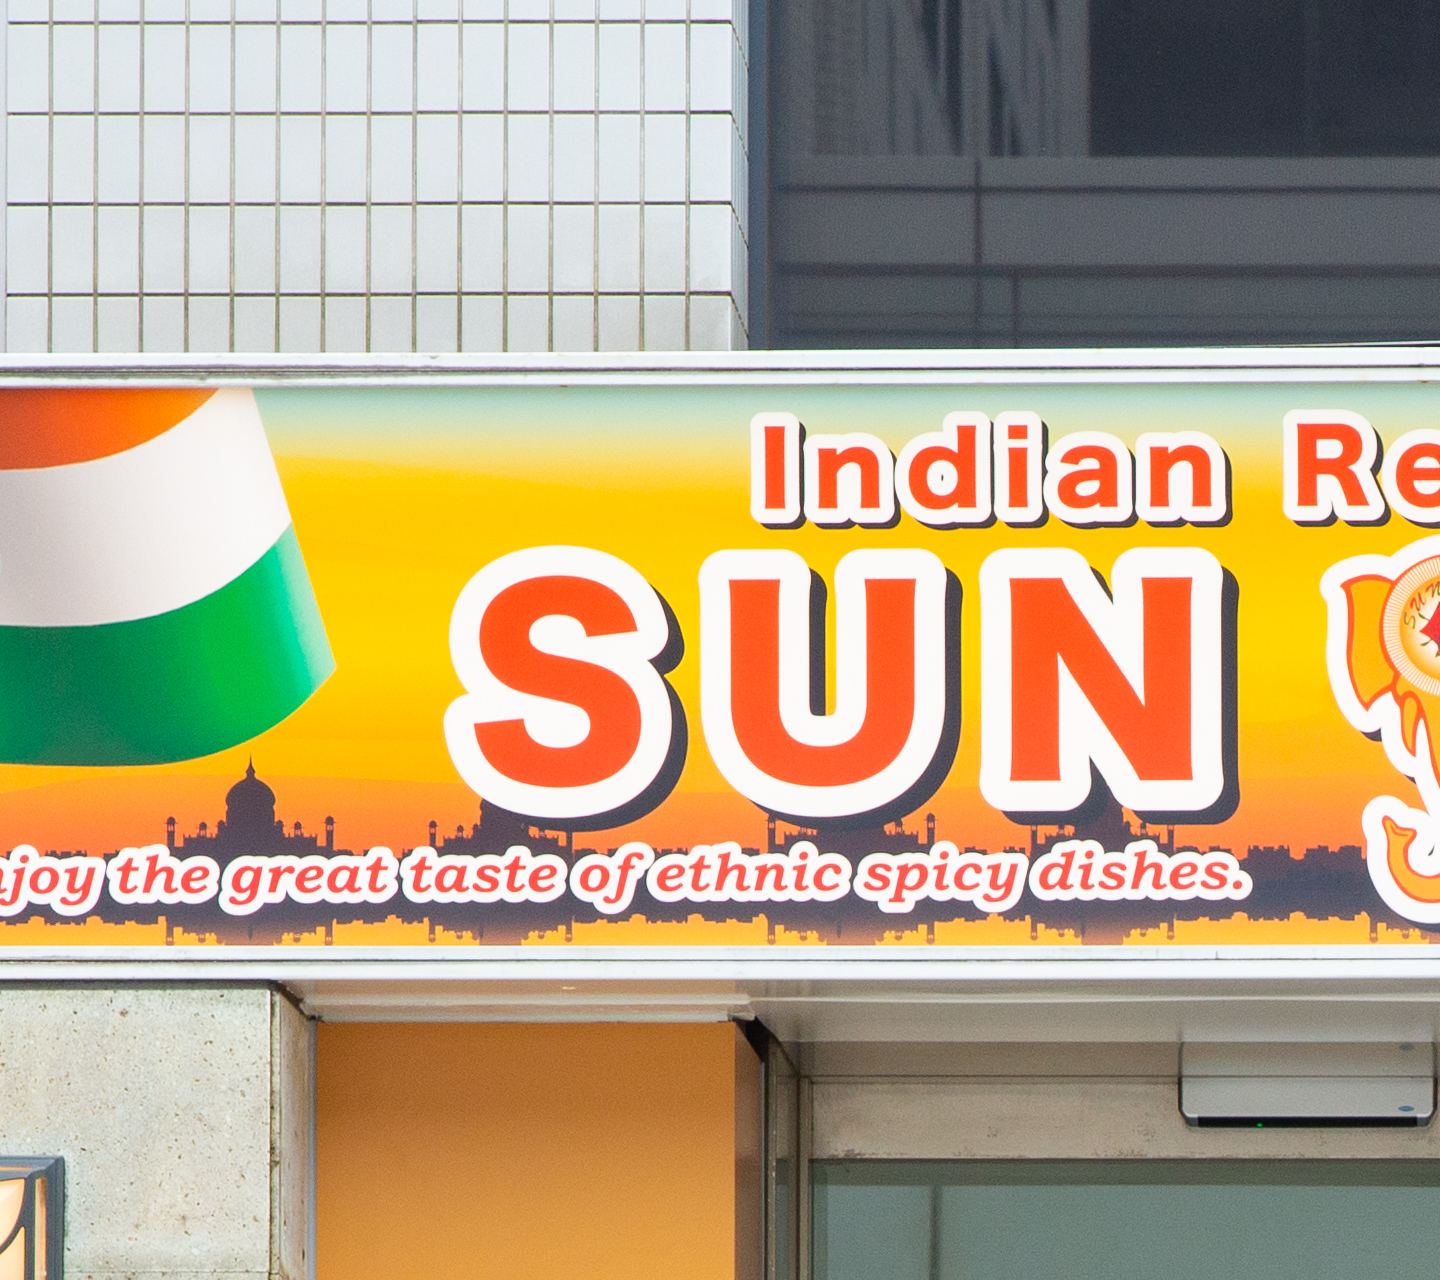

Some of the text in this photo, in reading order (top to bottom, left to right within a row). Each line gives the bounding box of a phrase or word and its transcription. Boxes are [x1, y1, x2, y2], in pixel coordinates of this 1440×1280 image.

[756, 416, 1222, 518] Indian
[460, 558, 1212, 804] SUN
[108, 850, 218, 900] the
[228, 850, 391, 907] great
[406, 850, 566, 900] taste
[572, 848, 651, 907] of
[655, 846, 848, 900] ethnic
[858, 848, 1024, 907] spicy
[1038, 846, 1254, 900] dishes.
